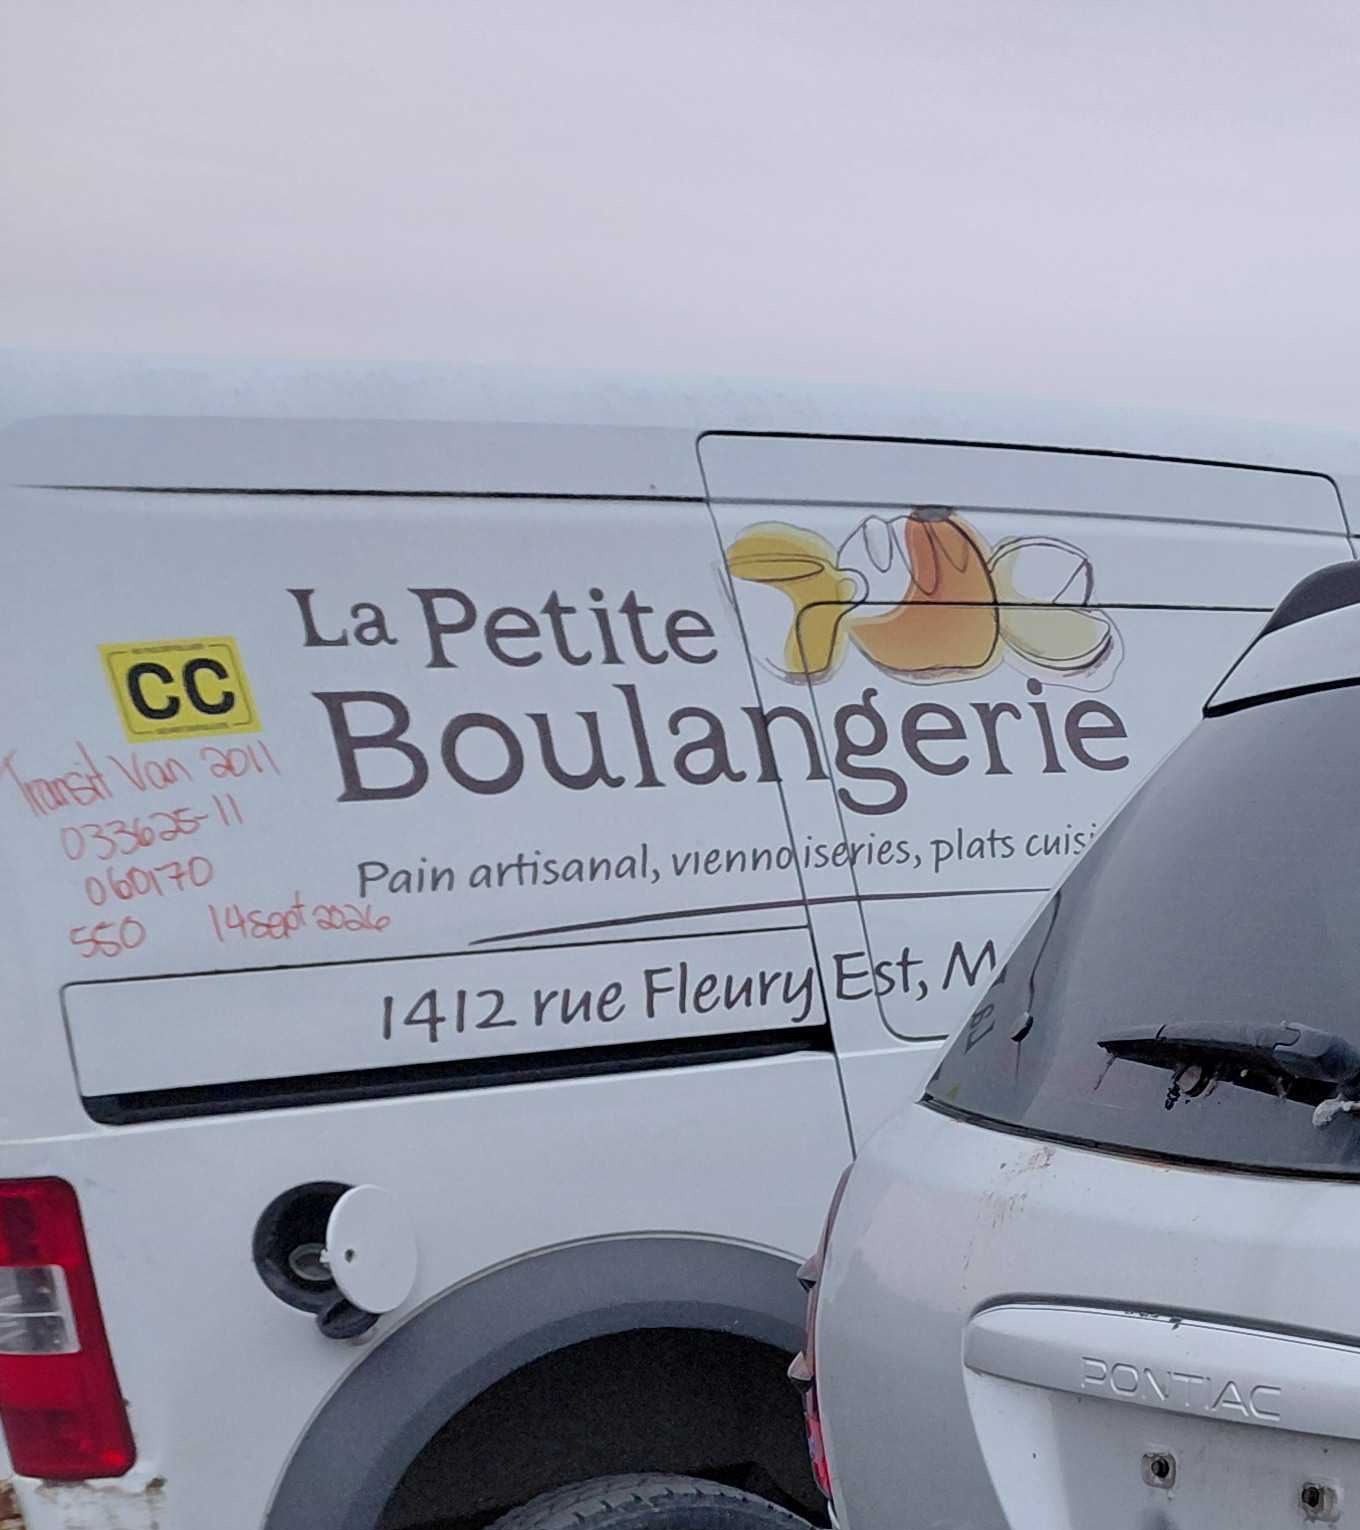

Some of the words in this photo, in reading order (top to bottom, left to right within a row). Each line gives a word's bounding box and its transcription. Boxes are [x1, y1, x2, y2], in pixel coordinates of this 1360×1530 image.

[286, 588, 398, 648] La
[407, 586, 719, 669] Petite
[126, 657, 236, 720] CC
[108, 751, 193, 793] Van
[199, 739, 283, 777] 2011
[310, 676, 1131, 816] Boulangerie
[357, 857, 455, 898] Pain
[468, 842, 661, 886] artisanal,
[672, 833, 923, 878] viennoiseries,
[929, 826, 1016, 873] plats
[382, 987, 518, 1043] 1412
[533, 979, 626, 1027] rue
[643, 960, 815, 1023] Fleury
[832, 946, 929, 1002] Est,
